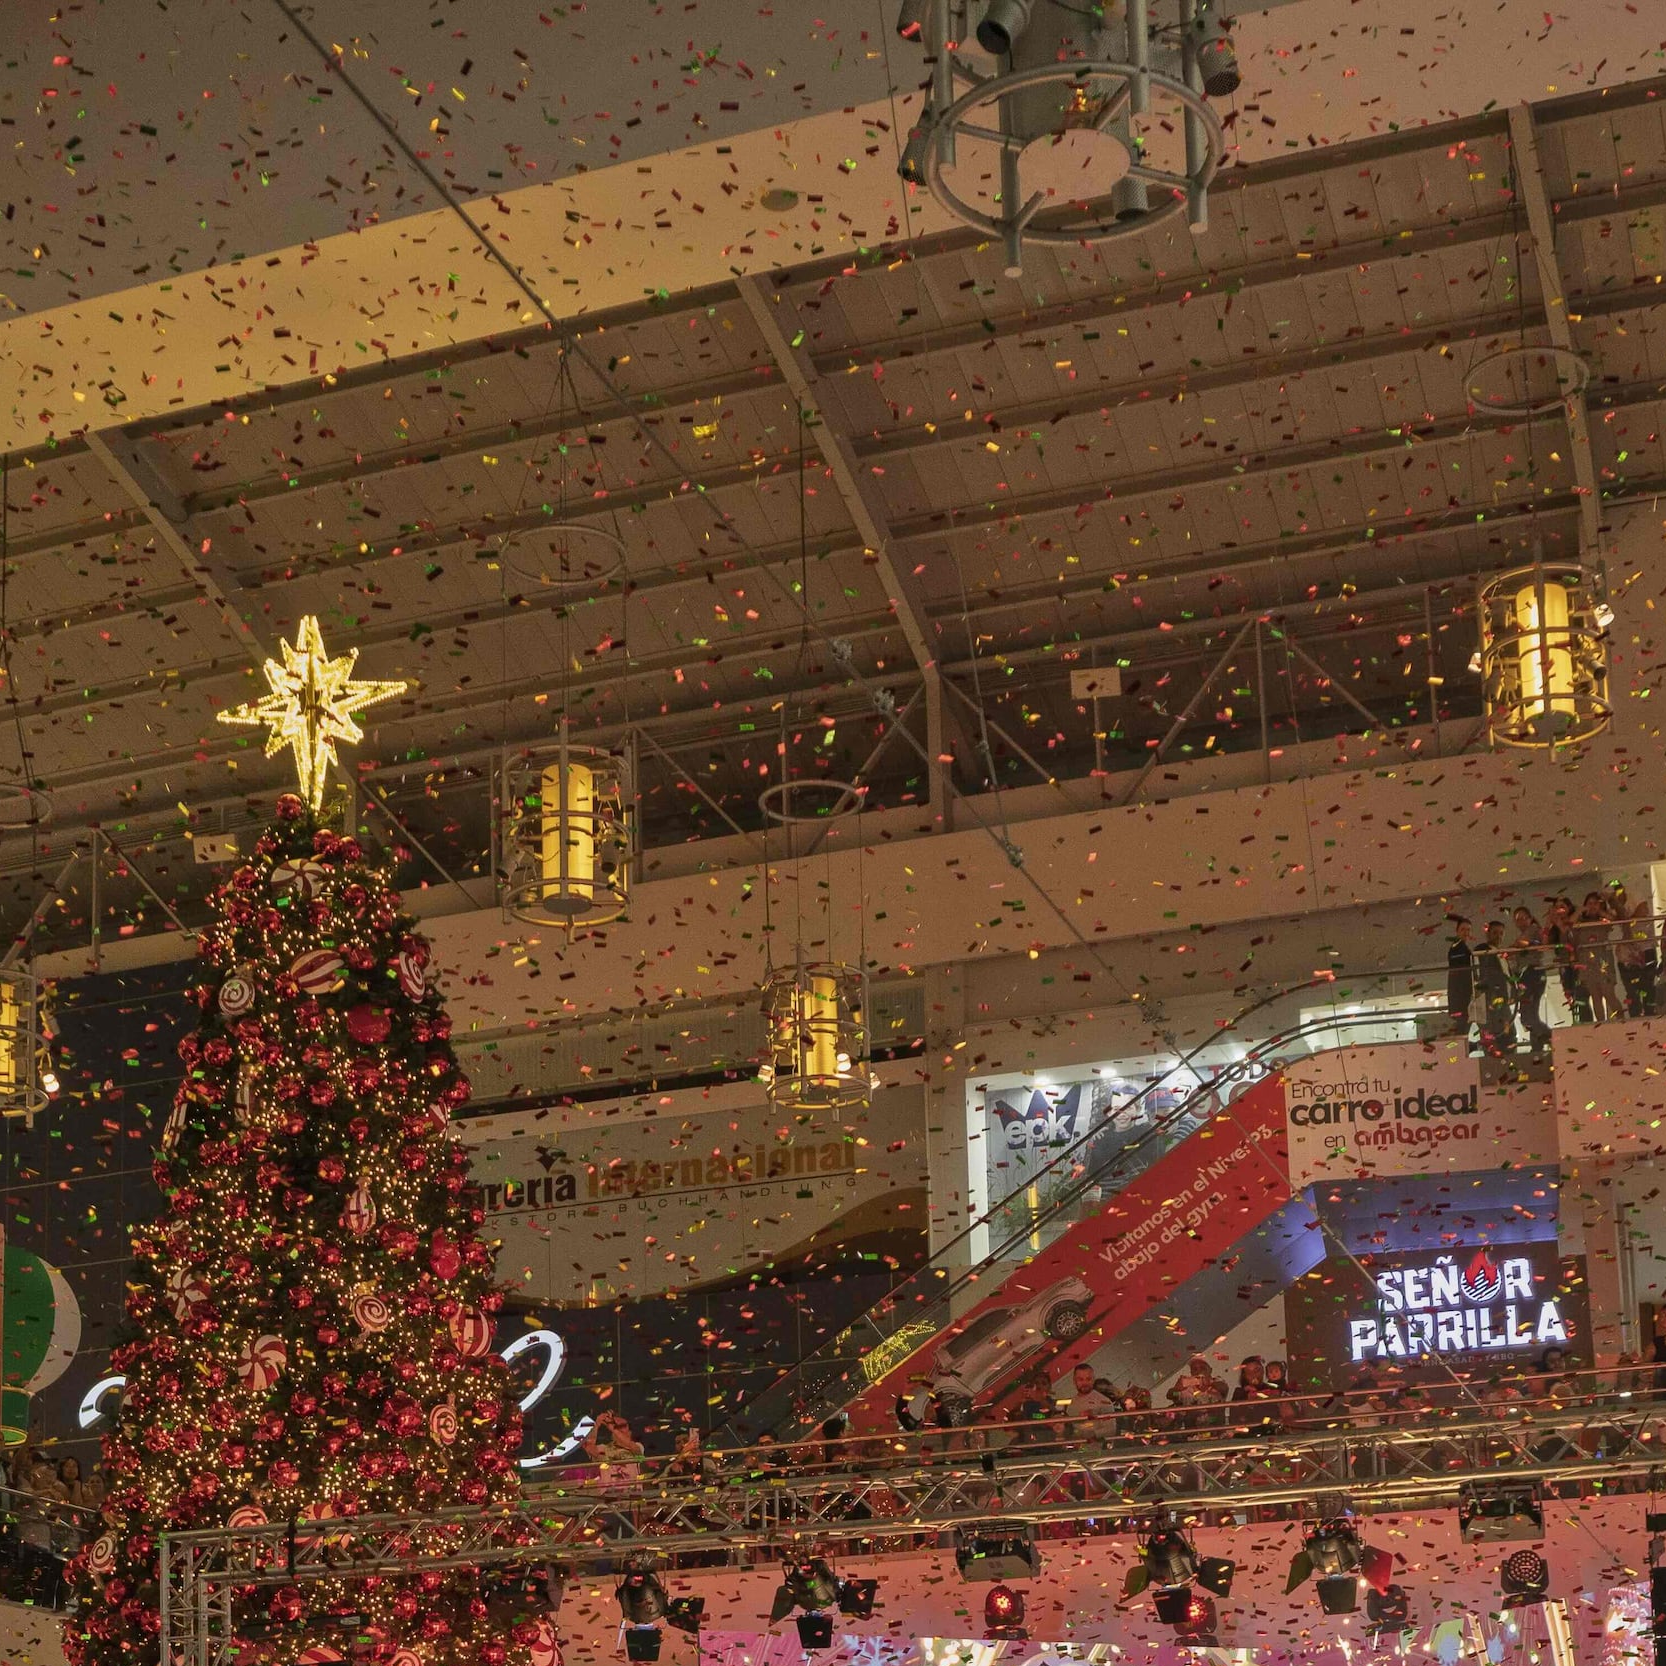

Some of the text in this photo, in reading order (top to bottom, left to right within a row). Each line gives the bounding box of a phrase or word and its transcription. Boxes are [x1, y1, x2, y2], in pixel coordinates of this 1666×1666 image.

[1373, 1078, 1391, 1094] tu
[1290, 1099, 1384, 1126] carro
[1324, 1123, 1480, 1148] en ambacar
[1171, 1189, 1194, 1209] en
[1193, 1172, 1210, 1192] el
[1114, 1241, 1160, 1280] abajo
[1160, 1217, 1187, 1244] del
[1376, 1250, 1534, 1313] SEÑOR
[1349, 1301, 1568, 1362] PARRILLA
